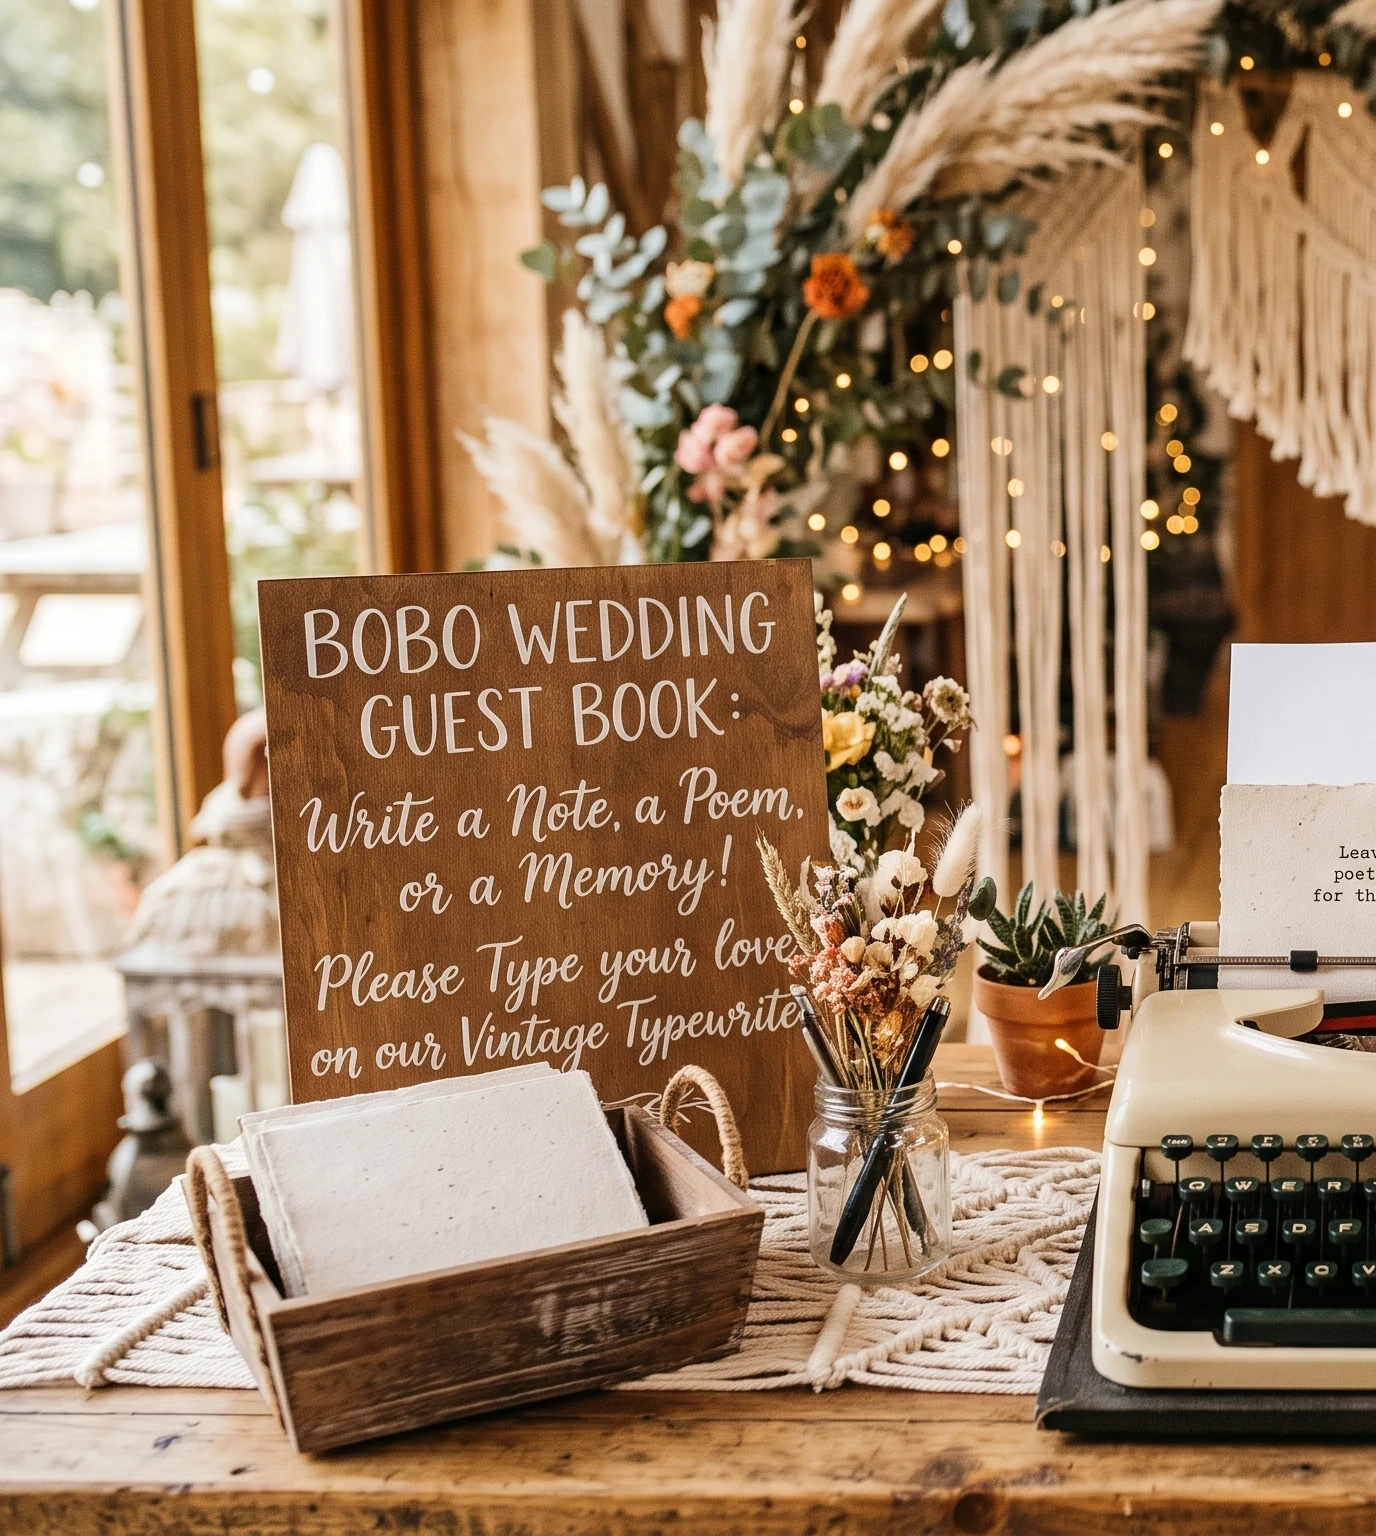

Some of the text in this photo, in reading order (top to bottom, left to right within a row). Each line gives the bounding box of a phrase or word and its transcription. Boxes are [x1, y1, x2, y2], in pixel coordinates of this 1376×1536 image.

[303, 591, 776, 679] BOBO WEDDING
[360, 677, 742, 759] GUEST BOOK:
[299, 766, 804, 854] Write a Note, a Poem,
[399, 834, 733, 916] or a Memory!
[1313, 888, 1344, 902] for
[313, 917, 798, 1014] Please Type your love
[310, 987, 802, 1079] on our Vintage Typewrite
[1188, 1180, 1206, 1191] Q
[1234, 1180, 1253, 1191] W
[1281, 1181, 1297, 1191] E
[1327, 1181, 1342, 1191] R
[1197, 1222, 1213, 1233] A
[1244, 1223, 1259, 1233] S
[1292, 1223, 1307, 1233] D
[1338, 1223, 1353, 1233] F
[1219, 1264, 1235, 1275] Z
[1267, 1264, 1282, 1275] X
[1362, 1264, 1376, 1275] V
